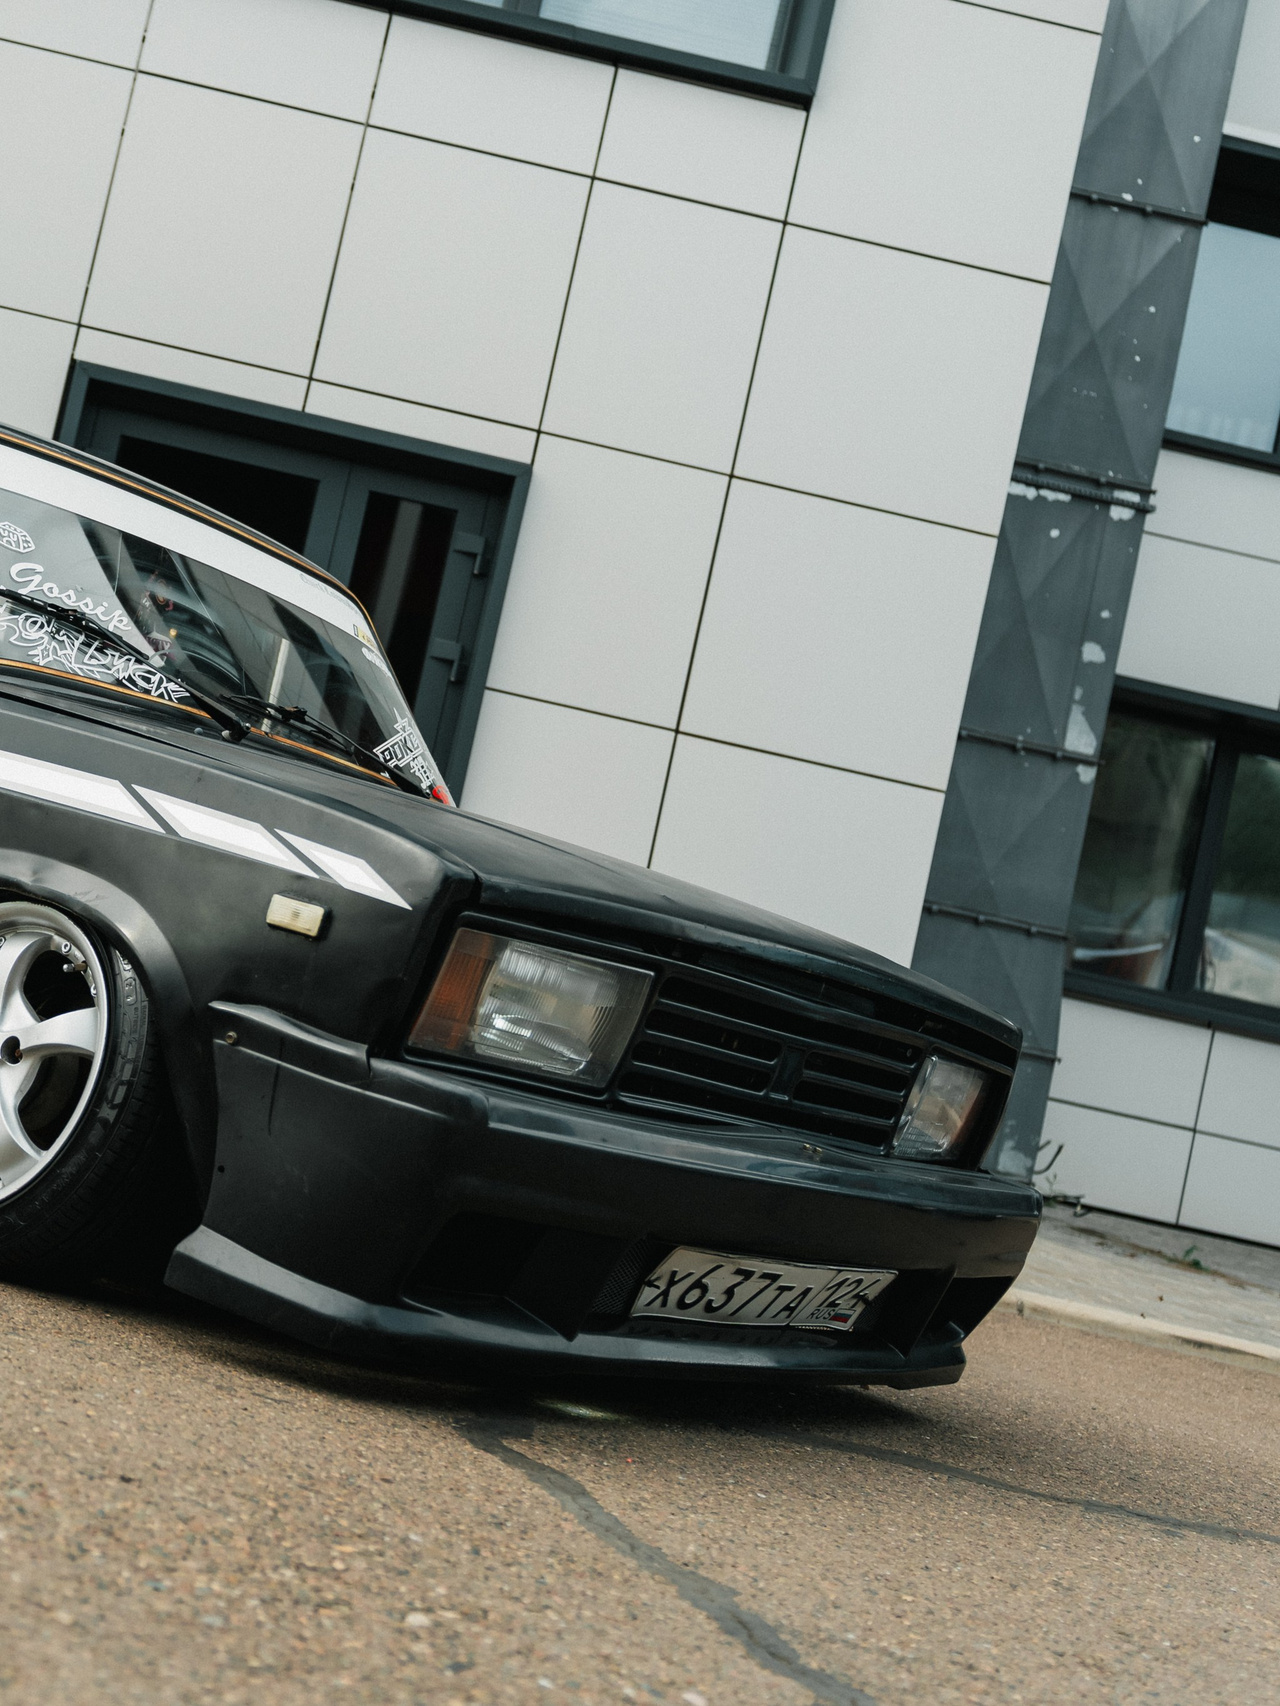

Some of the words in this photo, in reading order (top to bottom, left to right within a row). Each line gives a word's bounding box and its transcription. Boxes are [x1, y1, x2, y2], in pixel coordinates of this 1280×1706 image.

[9, 562, 132, 632] Gossip
[817, 1276, 882, 1309] 124
[807, 1308, 835, 1320] RUS
